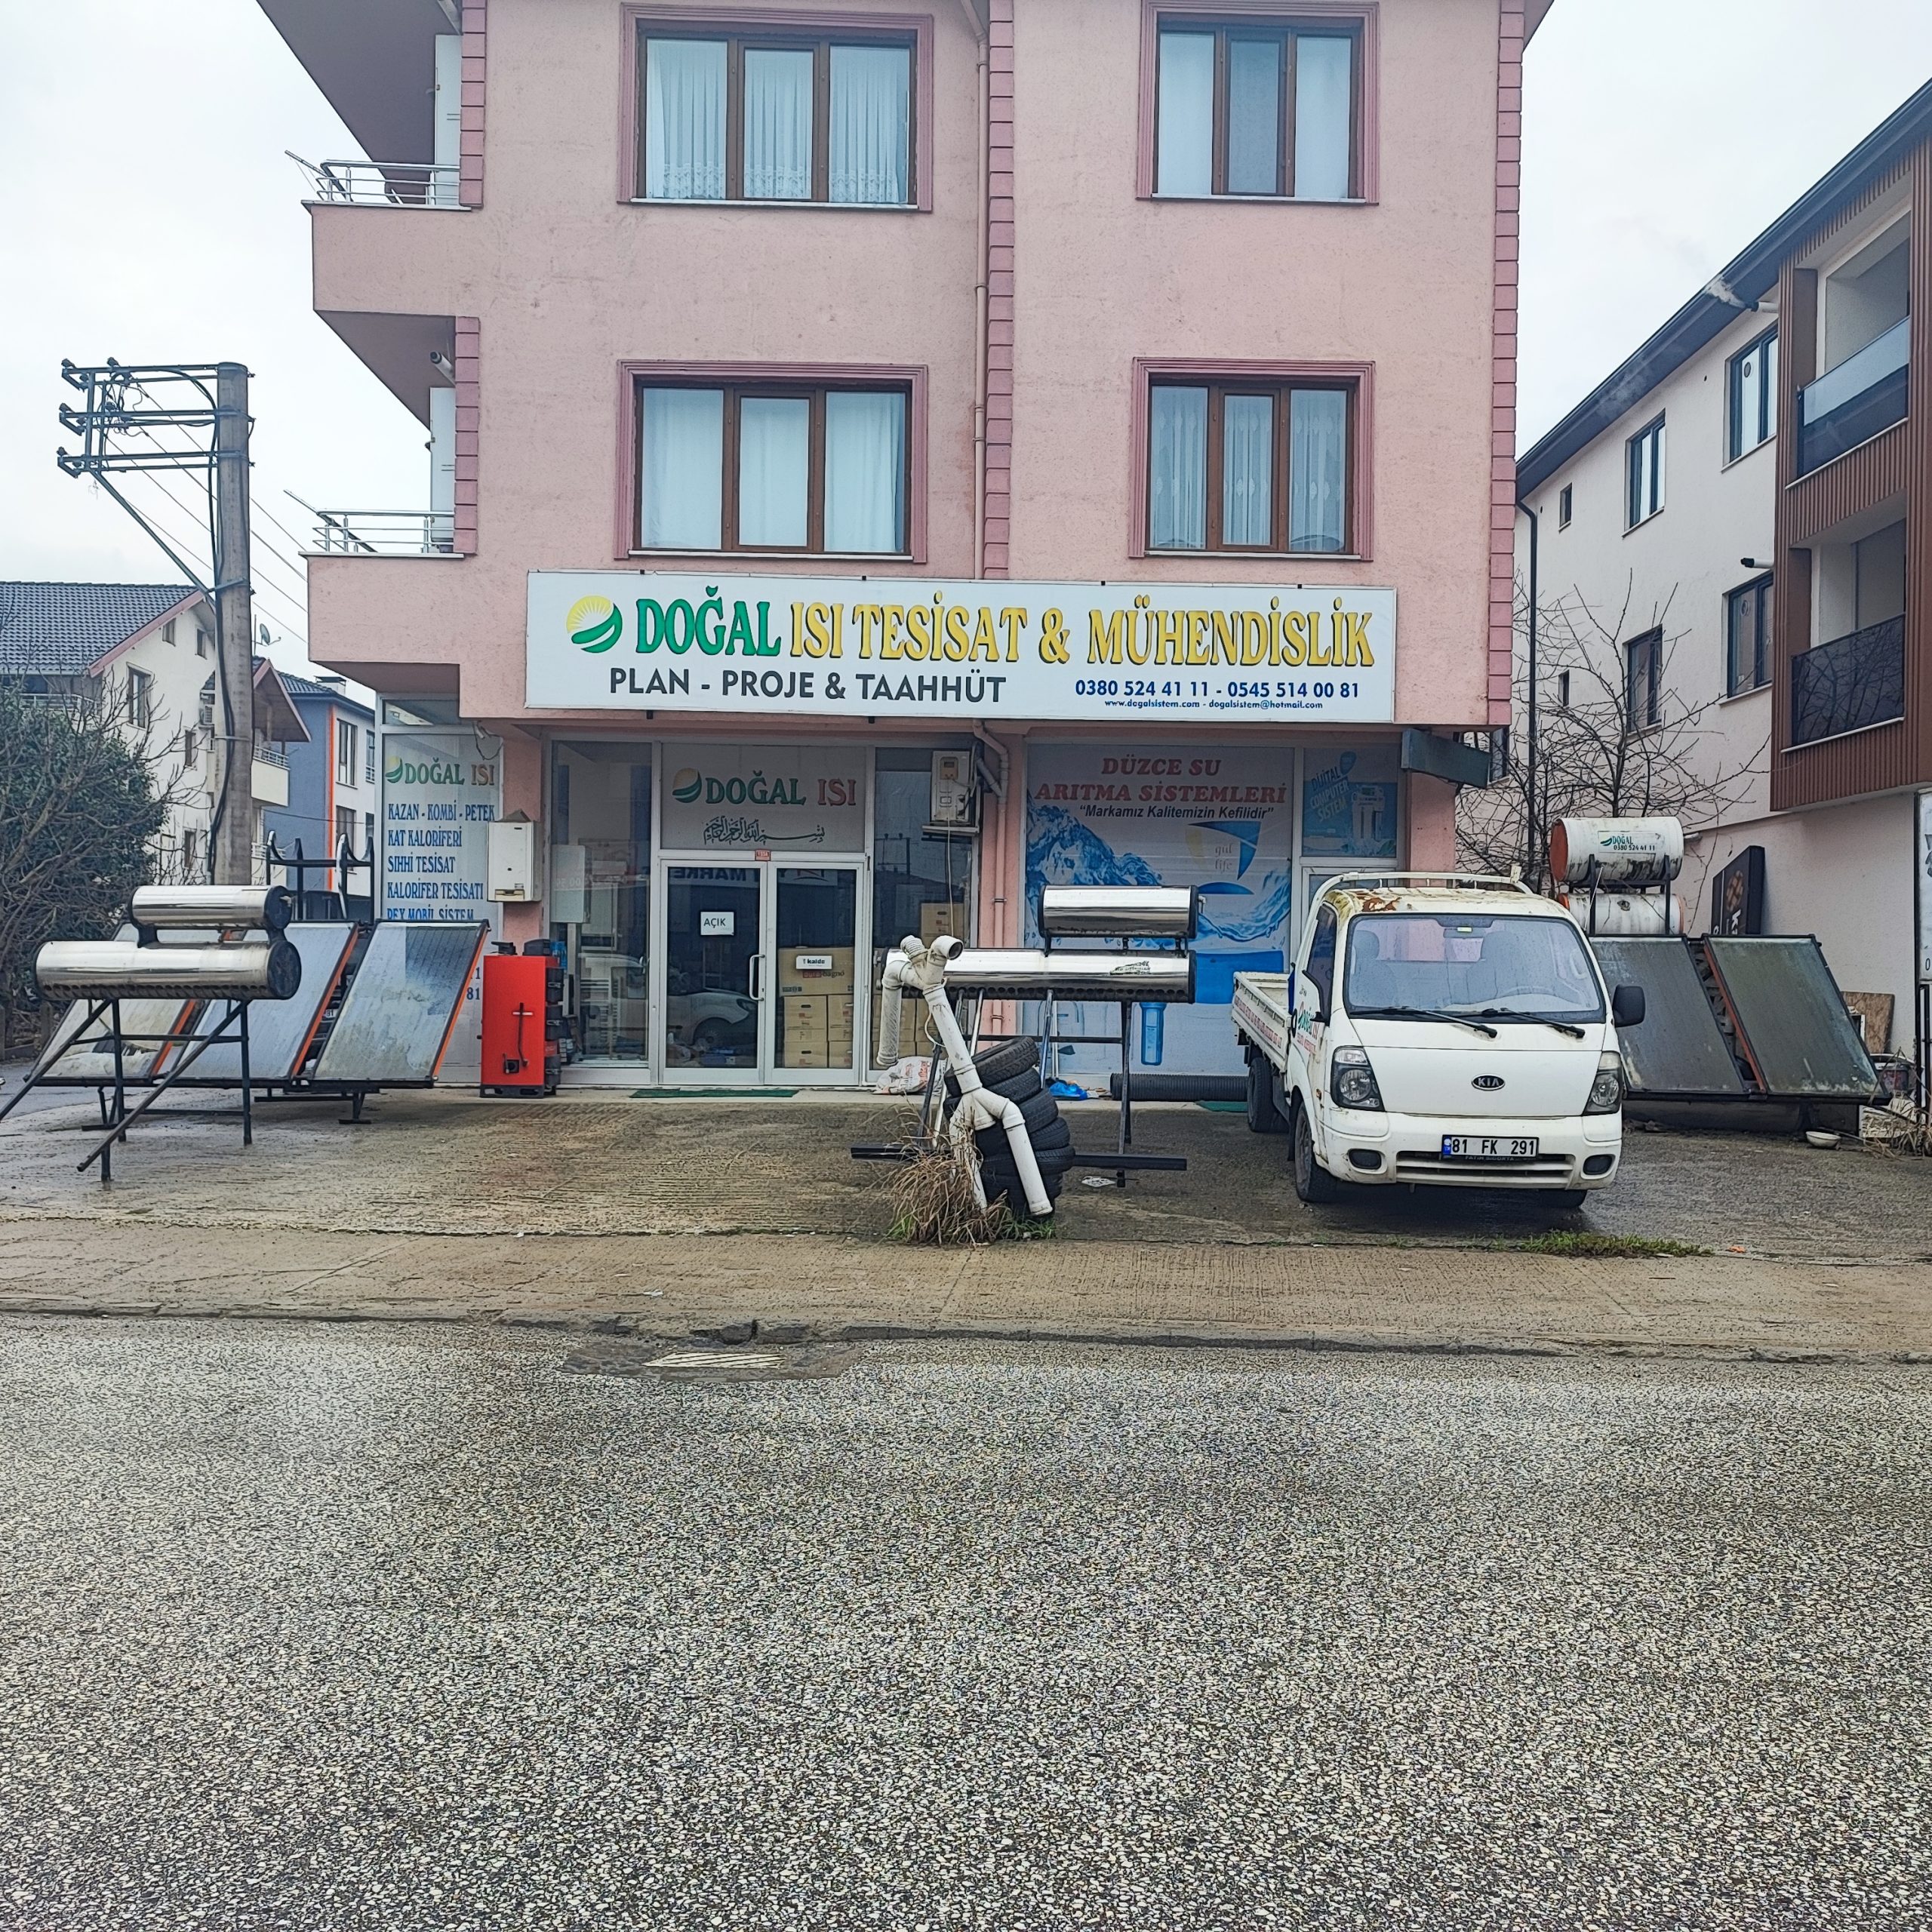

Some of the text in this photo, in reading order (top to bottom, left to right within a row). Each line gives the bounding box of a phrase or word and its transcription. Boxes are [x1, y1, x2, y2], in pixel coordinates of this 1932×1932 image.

[635, 585, 1375, 667] DOĞAL ISI TESİSAT & MÜHENDİSLİK
[611, 667, 690, 694] PLAN
[722, 670, 814, 699] PROJE
[825, 672, 846, 700] &
[856, 668, 1007, 703] TAAHHÜT
[1075, 679, 1118, 696] 0380
[1124, 680, 1156, 697] 524
[1161, 681, 1181, 697] 41
[1190, 681, 1208, 697] 11
[1227, 681, 1270, 697] 0545
[1275, 681, 1308, 698] 514
[1313, 681, 1334, 698] 00
[1340, 682, 1358, 698] 81
[1105, 699, 1200, 709] www.dogalsistem.com
[1208, 699, 1323, 710] dogalsistem@hotmail.com
[404, 757, 495, 786] DOĞAL ISI
[1101, 753, 1220, 776] DÜZCE SU
[704, 770, 857, 807] DOĞAL ISI
[1035, 781, 1286, 804] ARITMA SİSTEMLERİ
[1309, 779, 1349, 810] COMPUTER
[388, 803, 420, 820] KAZAN
[427, 799, 457, 821] KOMBİ
[465, 804, 495, 822] PETEK
[1146, 804, 1216, 819] Kalitemizin
[388, 825, 463, 847] KAT KALORİFERİ
[1612, 833, 1634, 844] DOĞAL
[387, 851, 457, 874] SIHHİ TESİSAT
[386, 877, 484, 900] KALORİFER TESİSATI
[703, 918, 726, 929] AÇIK
[466, 987, 481, 1000] 81
[1478, 1077, 1500, 1087] KIA
[1452, 1138, 1468, 1154] 81
[1481, 1139, 1498, 1155] FK
[1510, 1140, 1534, 1155] 291
